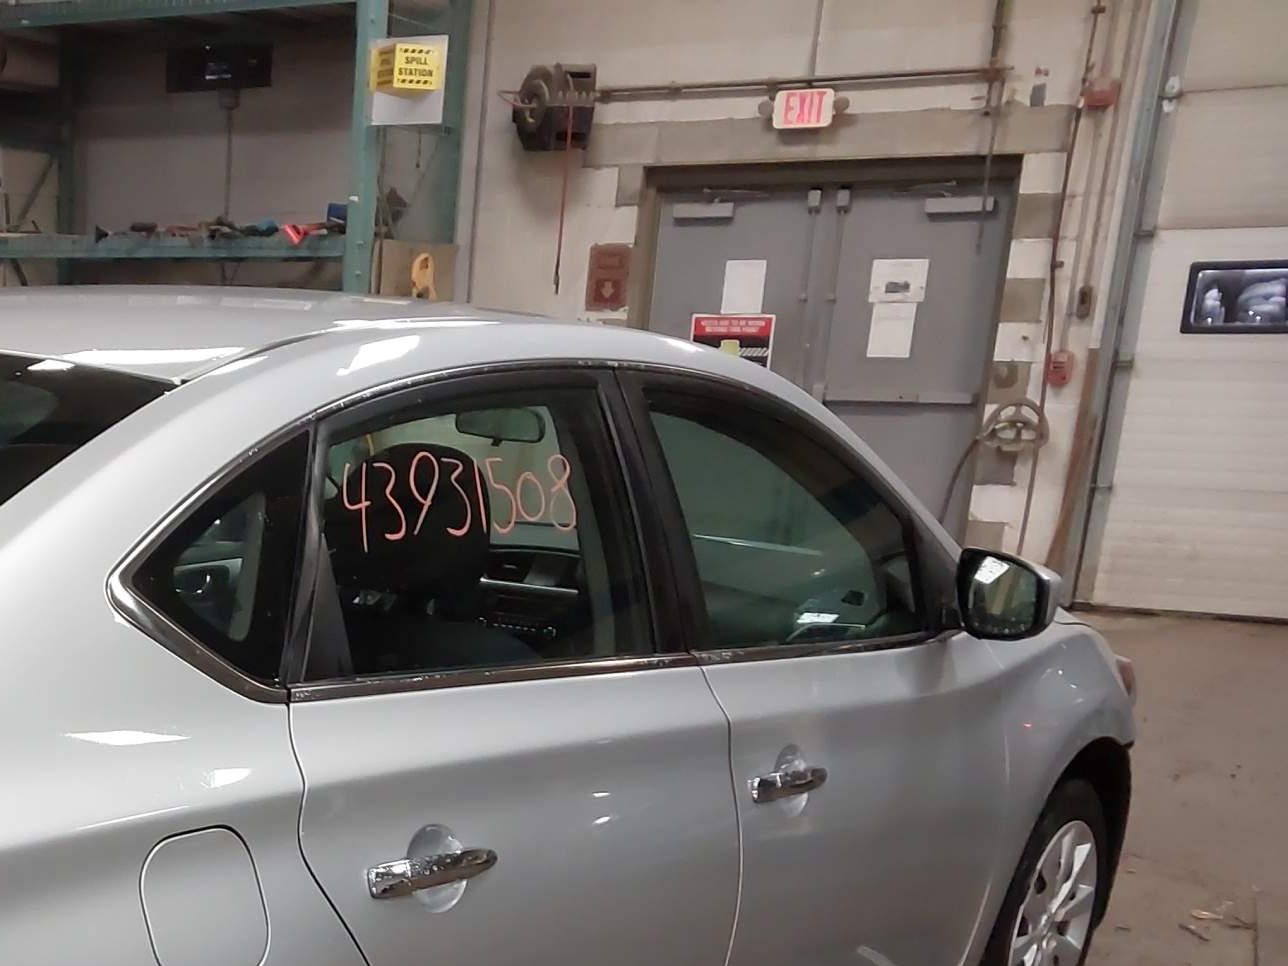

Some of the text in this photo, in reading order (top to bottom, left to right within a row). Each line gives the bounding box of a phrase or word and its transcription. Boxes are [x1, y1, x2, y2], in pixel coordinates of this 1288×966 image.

[397, 67, 434, 77] STATION
[404, 56, 429, 66] SPILL
[782, 91, 828, 126] EXIT
[342, 451, 578, 553] 43931508
